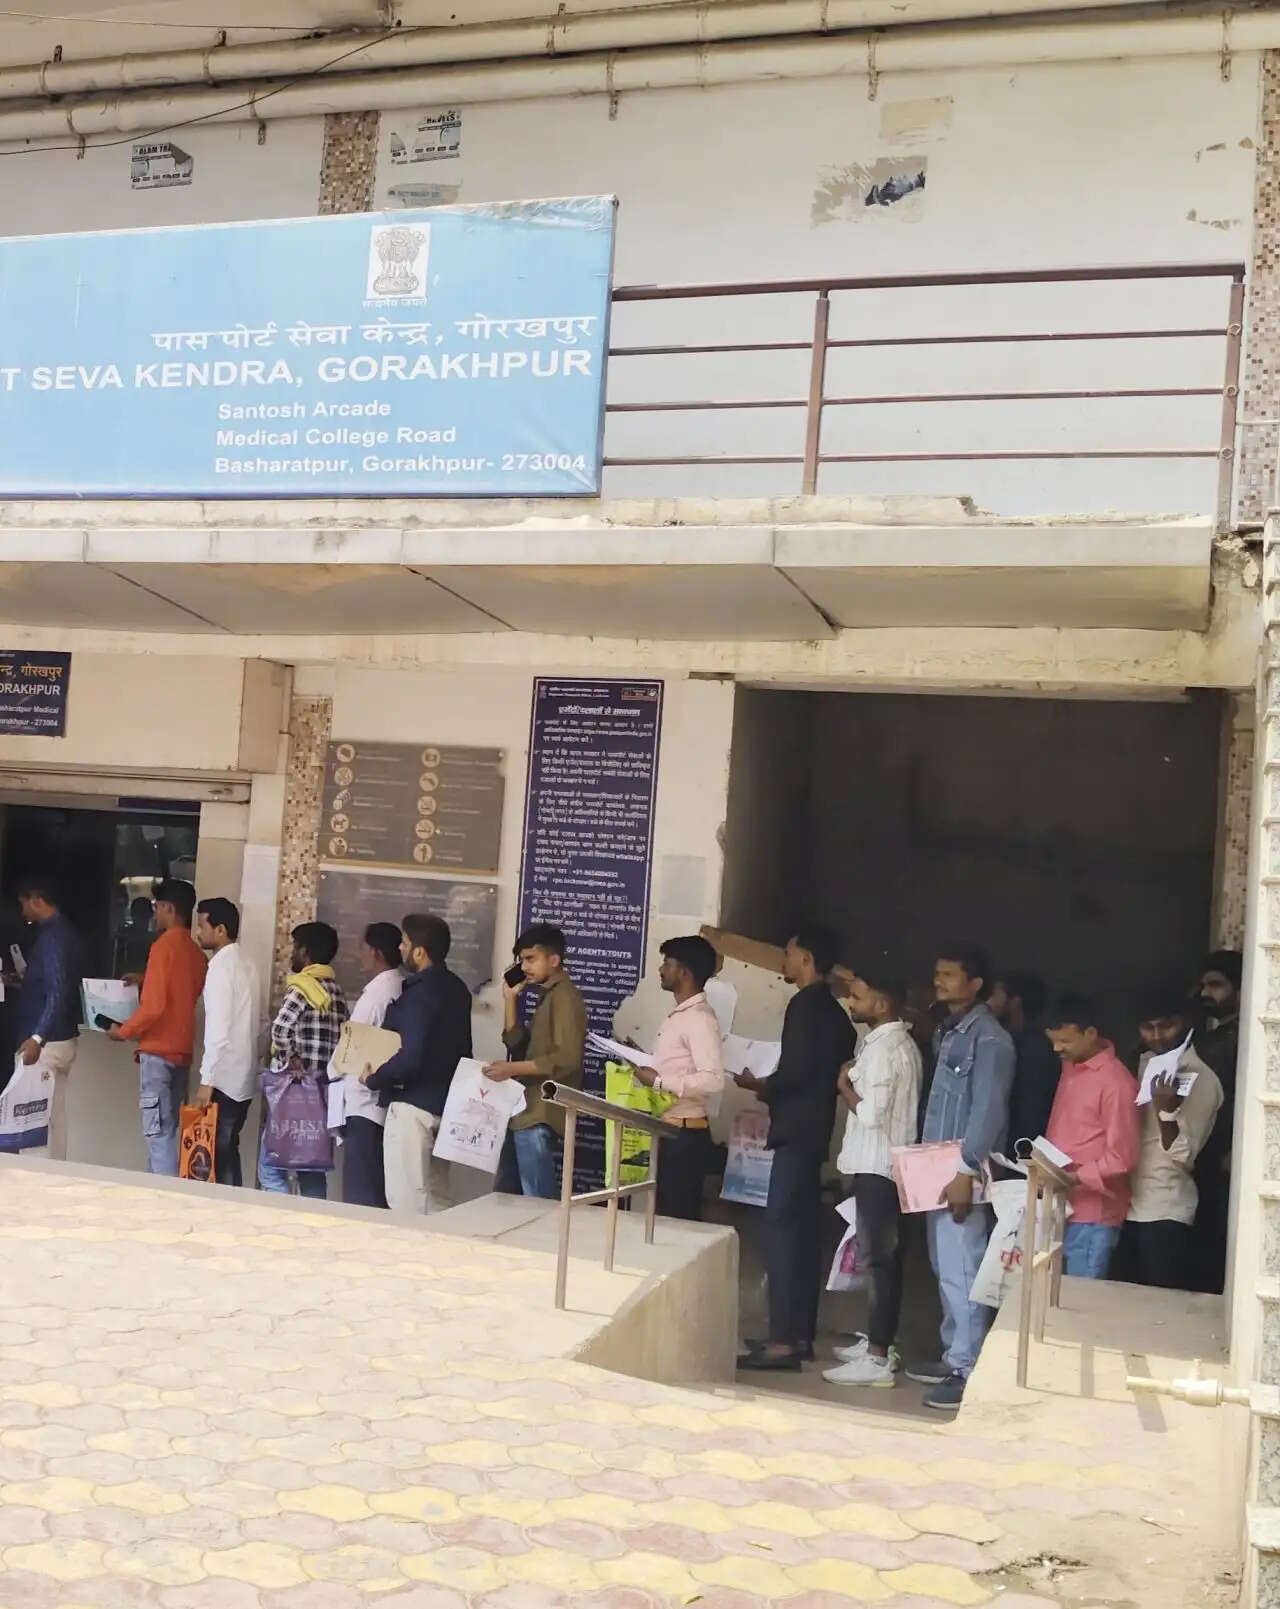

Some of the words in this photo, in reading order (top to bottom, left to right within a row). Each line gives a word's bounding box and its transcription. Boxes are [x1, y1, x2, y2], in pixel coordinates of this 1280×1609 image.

[151, 331, 209, 351] पास
[285, 320, 352, 347] सेवा
[453, 312, 598, 344] गोरखपुर
[31, 364, 124, 391] SEVA
[134, 357, 304, 388] KENDRA,
[318, 348, 593, 385] GORAKHPUR
[218, 401, 306, 421] Santosh
[312, 400, 392, 417] Arcade
[216, 428, 298, 447] Medical
[305, 426, 389, 448] College
[397, 425, 457, 444] Road
[215, 456, 355, 479] Basharatpur,
[362, 453, 495, 476] Gorakhpur-
[500, 452, 587, 473] 273004
